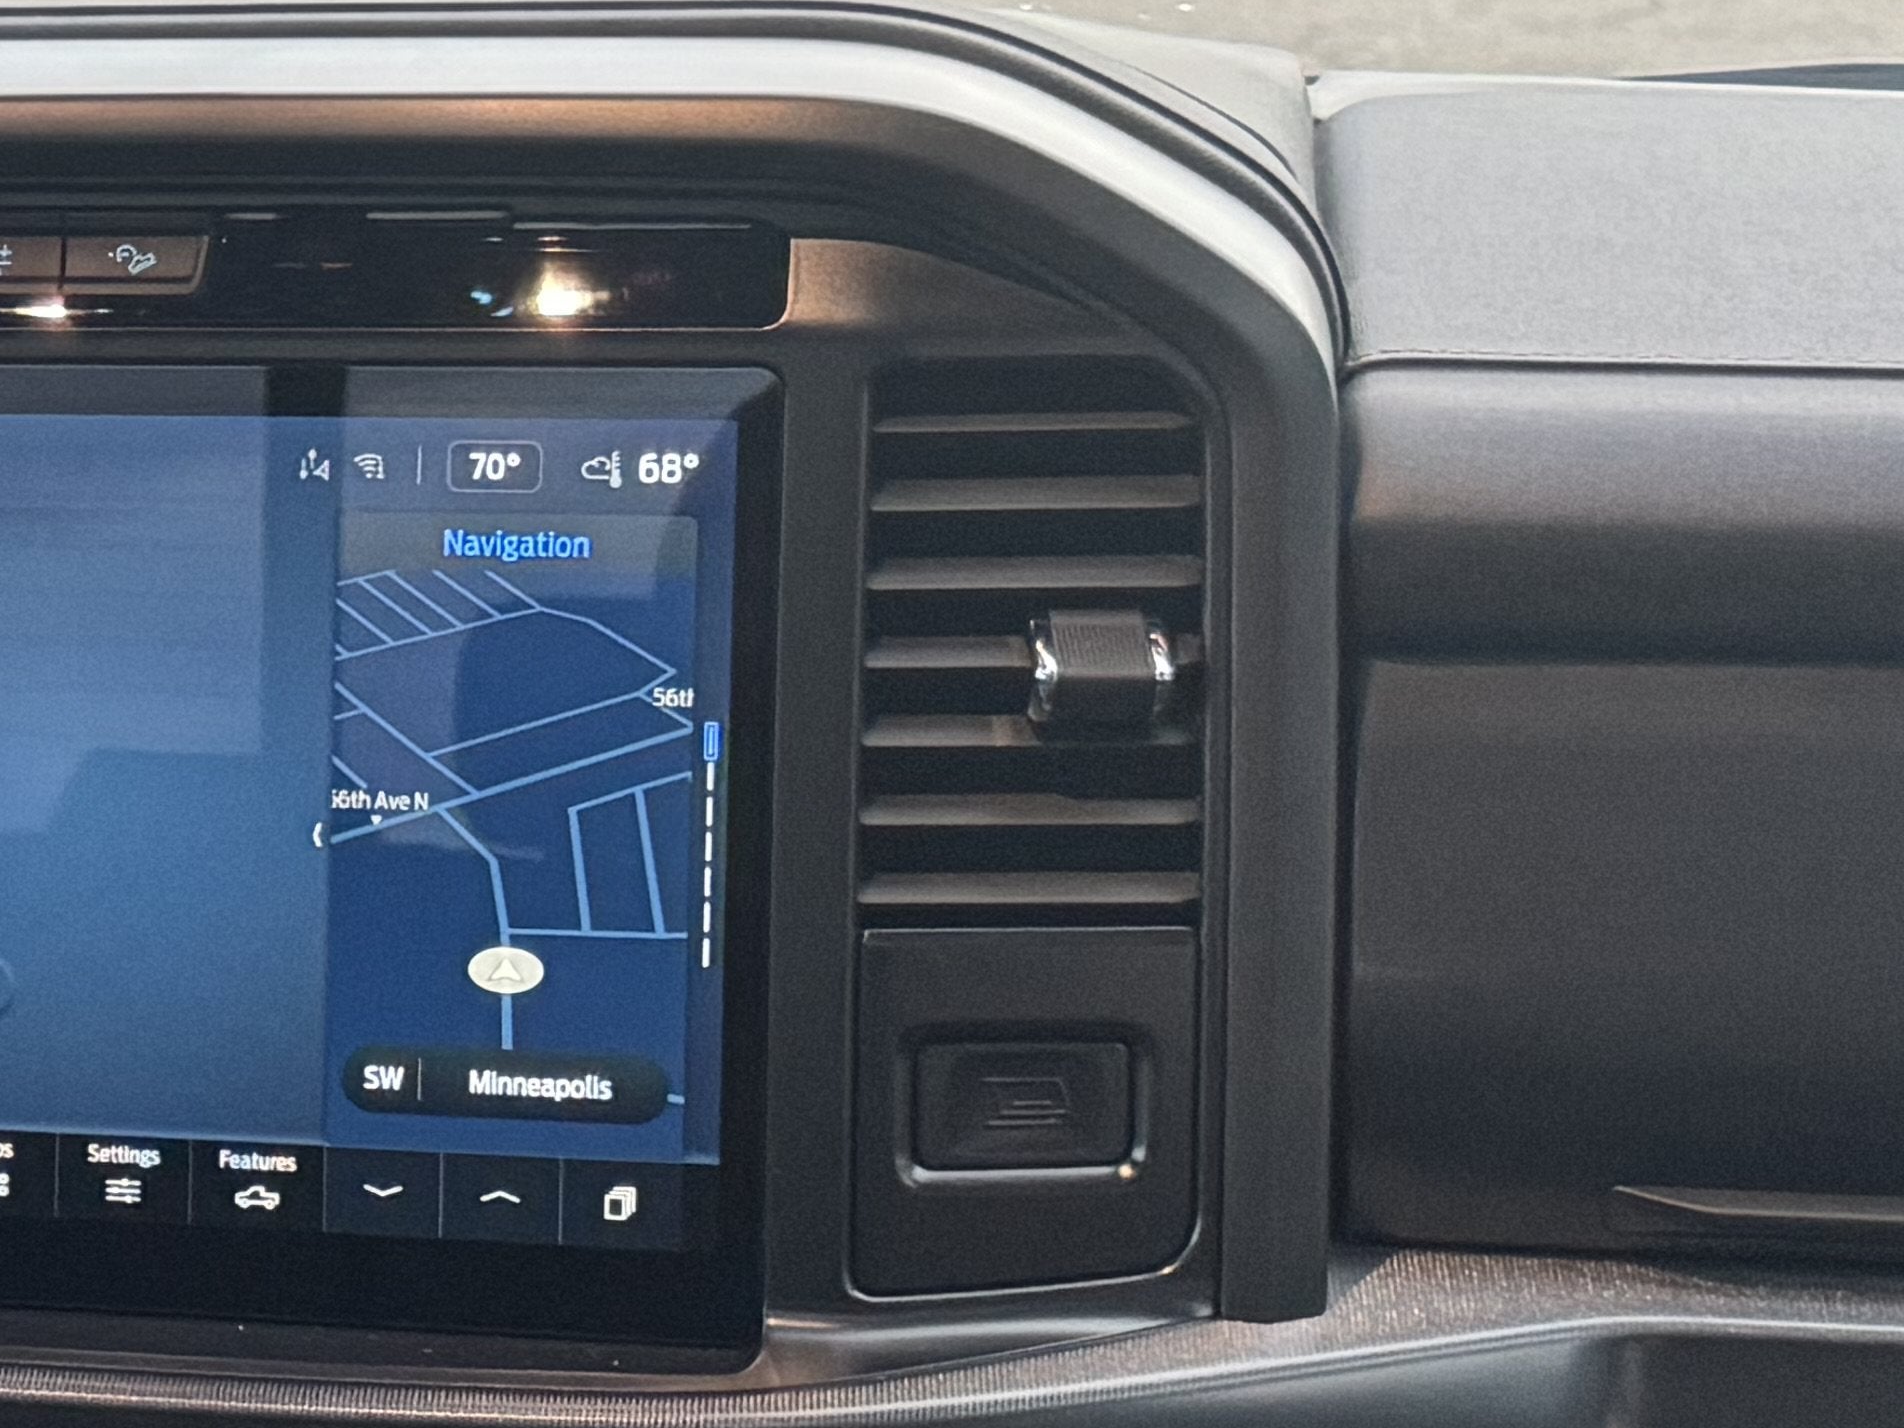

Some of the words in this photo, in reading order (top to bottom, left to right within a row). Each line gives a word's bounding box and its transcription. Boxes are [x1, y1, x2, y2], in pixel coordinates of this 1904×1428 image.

[468, 452, 521, 481] 70°
[638, 452, 700, 484] 68°
[442, 528, 592, 562] Navigation
[373, 790, 411, 810] Ave
[414, 791, 429, 810] N
[362, 1064, 405, 1092] SW
[468, 1068, 614, 1102] Minneapolis
[87, 1143, 162, 1169] Settings
[218, 1149, 299, 1174] Features
